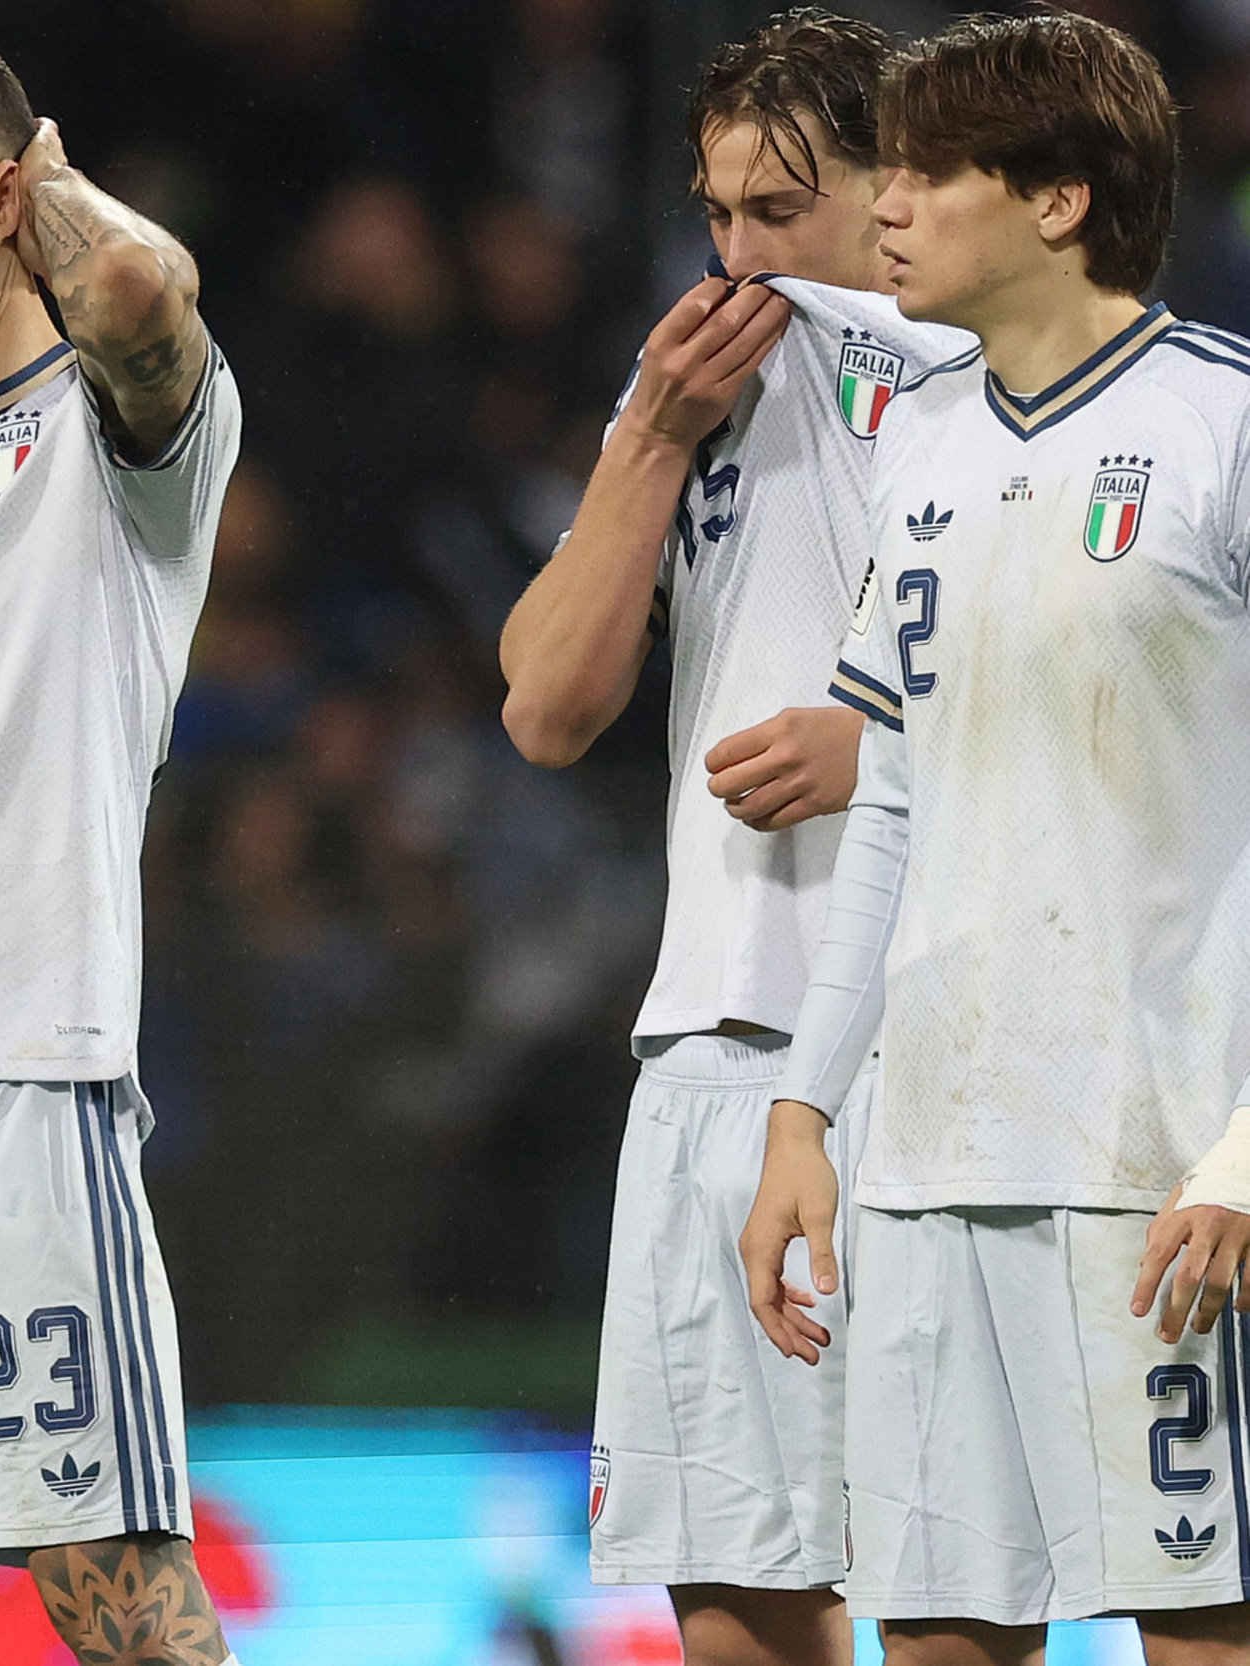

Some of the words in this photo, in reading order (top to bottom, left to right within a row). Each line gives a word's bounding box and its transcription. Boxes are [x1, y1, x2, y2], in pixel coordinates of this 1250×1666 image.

[845, 348, 894, 377] ITALIA
[1096, 477, 1140, 494] ITALIA
[896, 567, 942, 700] 2
[1146, 1364, 1215, 1496] 2
